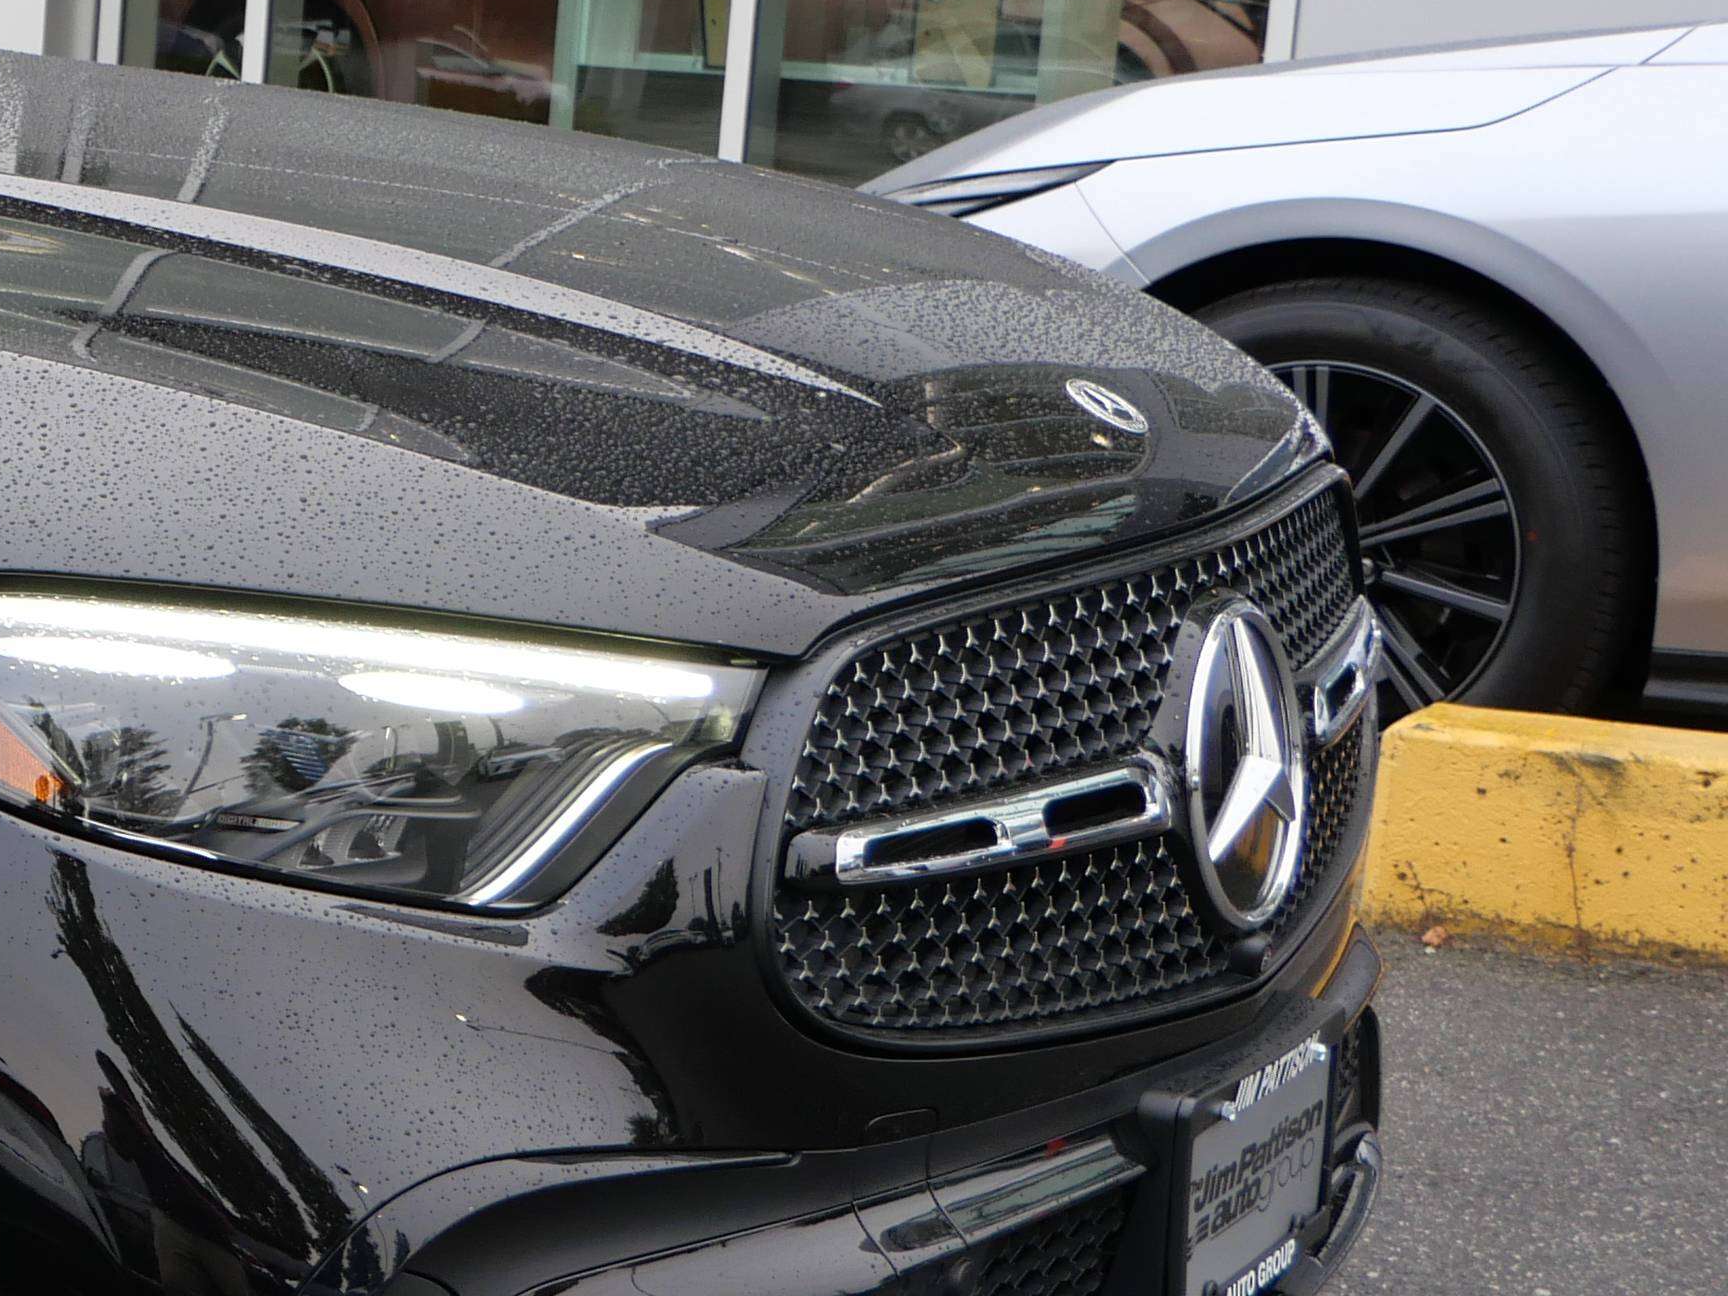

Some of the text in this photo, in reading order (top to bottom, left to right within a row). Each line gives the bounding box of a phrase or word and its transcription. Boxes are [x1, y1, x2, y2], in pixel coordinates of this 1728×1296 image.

[1194, 1100, 1324, 1213] Jim Pattison
[1257, 1238, 1296, 1288] GROUP
